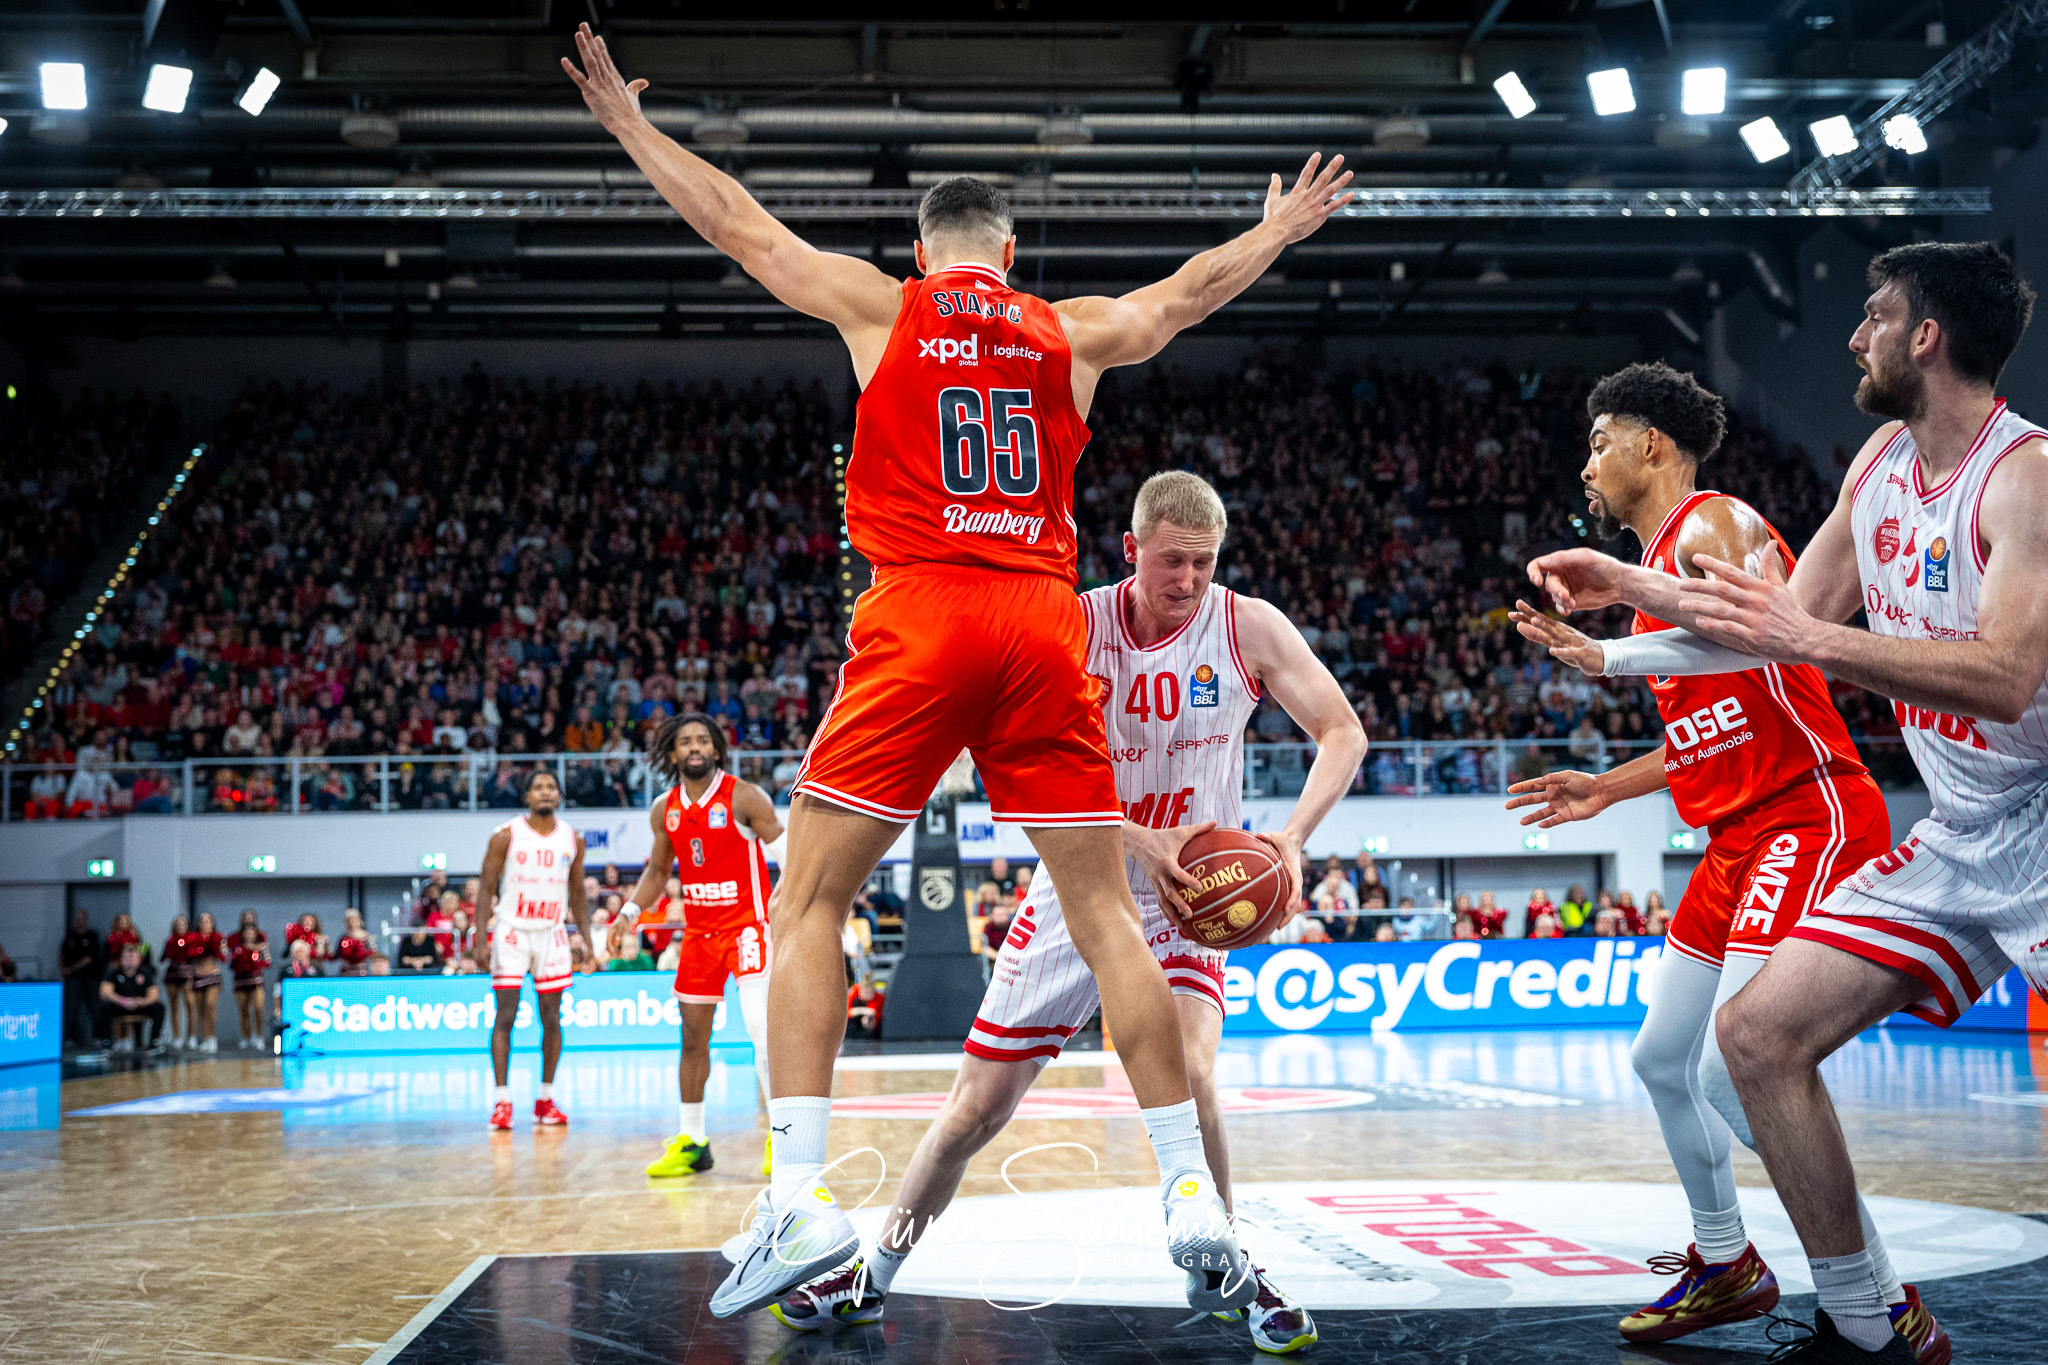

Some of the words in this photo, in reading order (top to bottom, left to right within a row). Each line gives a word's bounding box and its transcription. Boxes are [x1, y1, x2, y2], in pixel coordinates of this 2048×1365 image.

[918, 333, 978, 364] xpd
[993, 344, 1043, 361] logistics
[938, 387, 1040, 496] 65
[943, 504, 1045, 544] Bamberg
[1927, 576, 1946, 588] BBL
[1933, 626, 1980, 642] SPRINT
[1125, 671, 1180, 723] 40
[1193, 695, 1216, 704] BBL
[1665, 696, 1748, 751] ose
[1680, 754, 1695, 766] für
[1697, 731, 1754, 760] Automobie
[537, 850, 554, 868] 10
[690, 837, 705, 867] 3
[682, 880, 739, 900] rose
[1205, 927, 1231, 940] BBL
[1223, 940, 1664, 1031] e@syCredit
[559, 989, 727, 1031] Bambeg
[1305, 1192, 1652, 1279] brose
